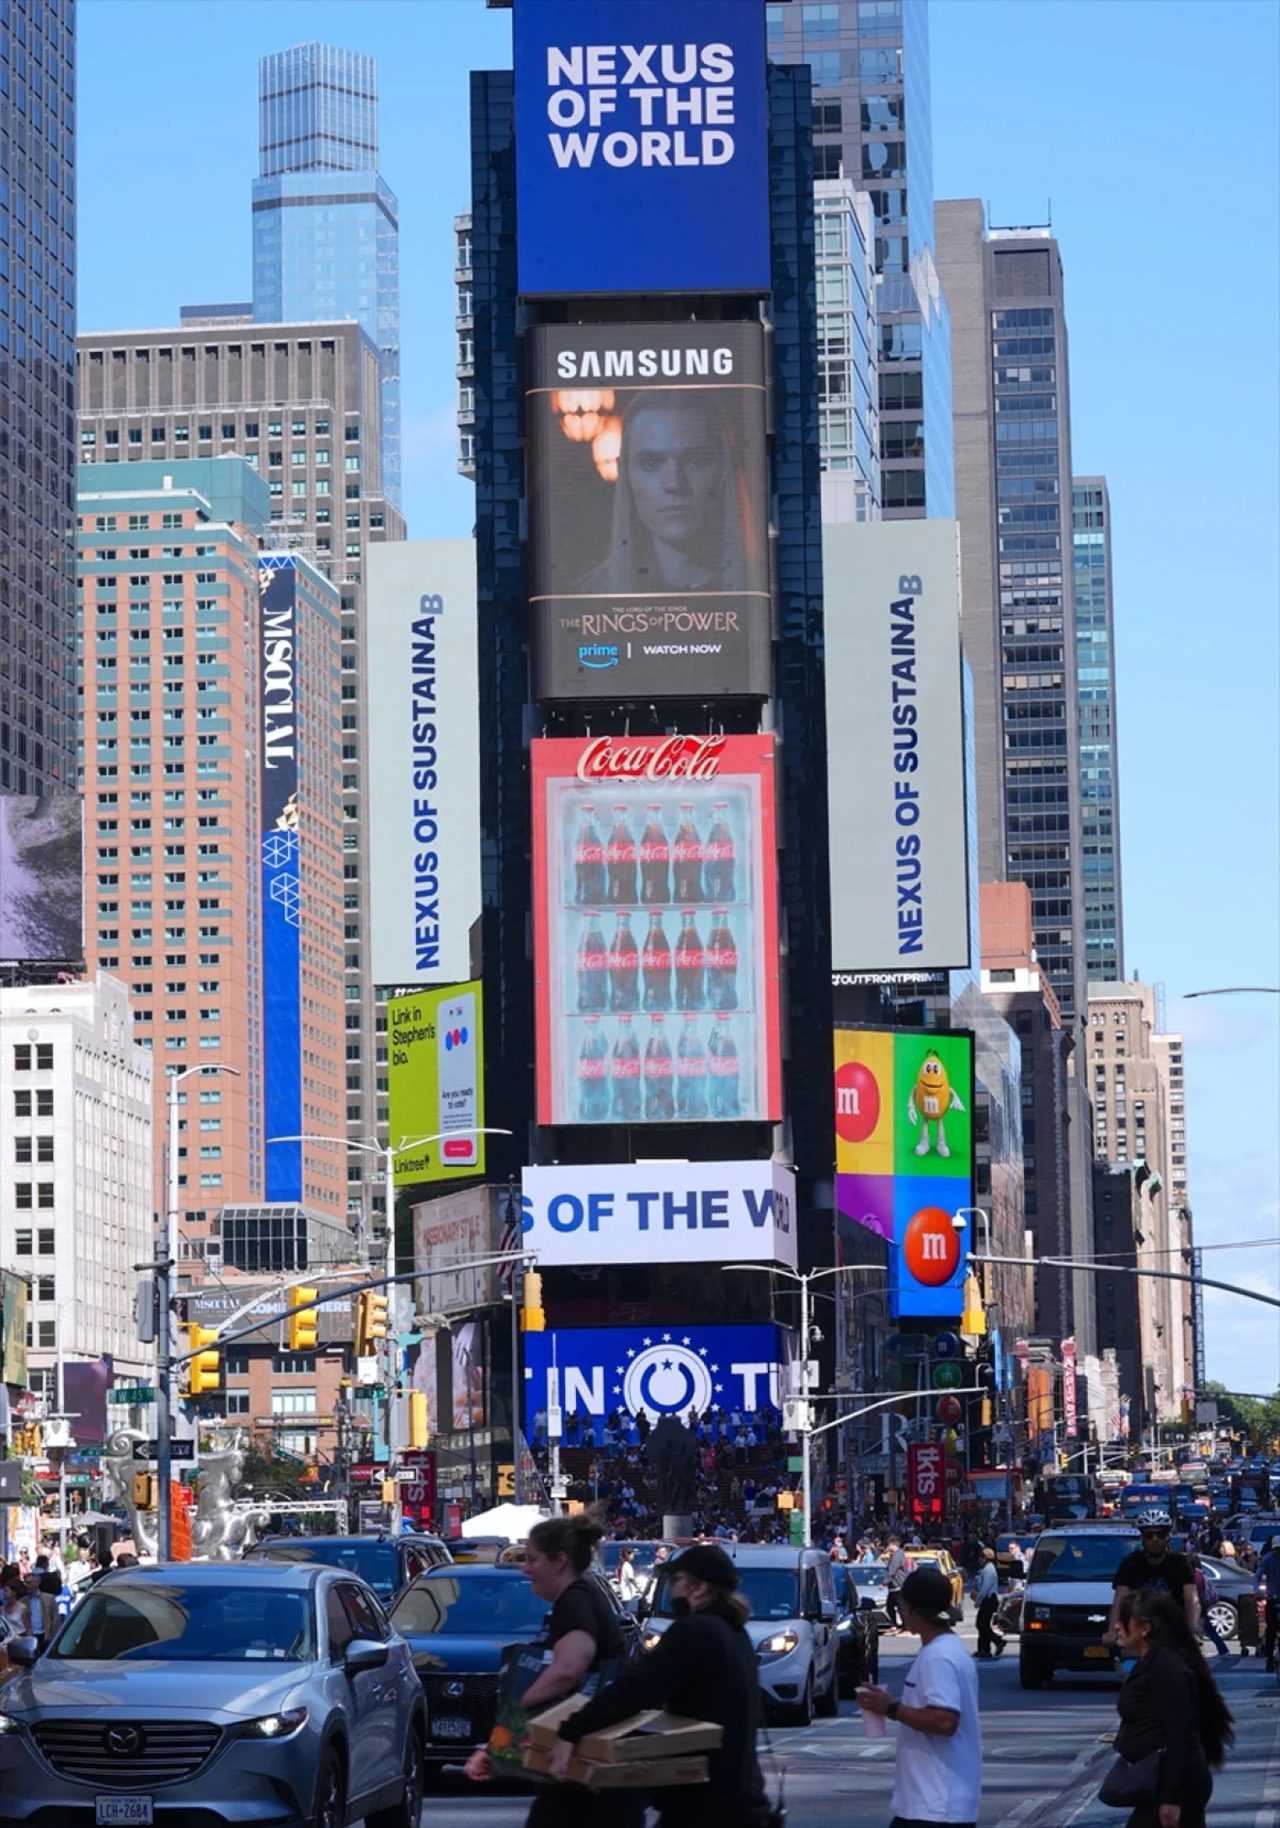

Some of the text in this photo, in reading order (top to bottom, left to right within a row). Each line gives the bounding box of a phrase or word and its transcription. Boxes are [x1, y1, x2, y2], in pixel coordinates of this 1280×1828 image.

[547, 43, 735, 85] NEXUS
[548, 87, 735, 127] OF THE
[548, 131, 735, 168] WORLD
[557, 348, 734, 378] SAMSUNG
[560, 618, 581, 628] THE
[581, 613, 649, 636] RINGS
[664, 611, 740, 632] POWER
[578, 643, 619, 658] prime
[643, 644, 722, 655] WATCH NOW
[411, 594, 444, 970] NEXUS OF SUSTAINAB
[890, 574, 924, 954] NEXUS OF SUSTAINAB
[392, 1006, 422, 1025] Link in
[392, 1022, 435, 1047] Stephen's
[548, 1193, 615, 1233] OF
[626, 1190, 729, 1231] THE
[547, 1365, 605, 1415] IN
[917, 1447, 940, 1495] tkts
